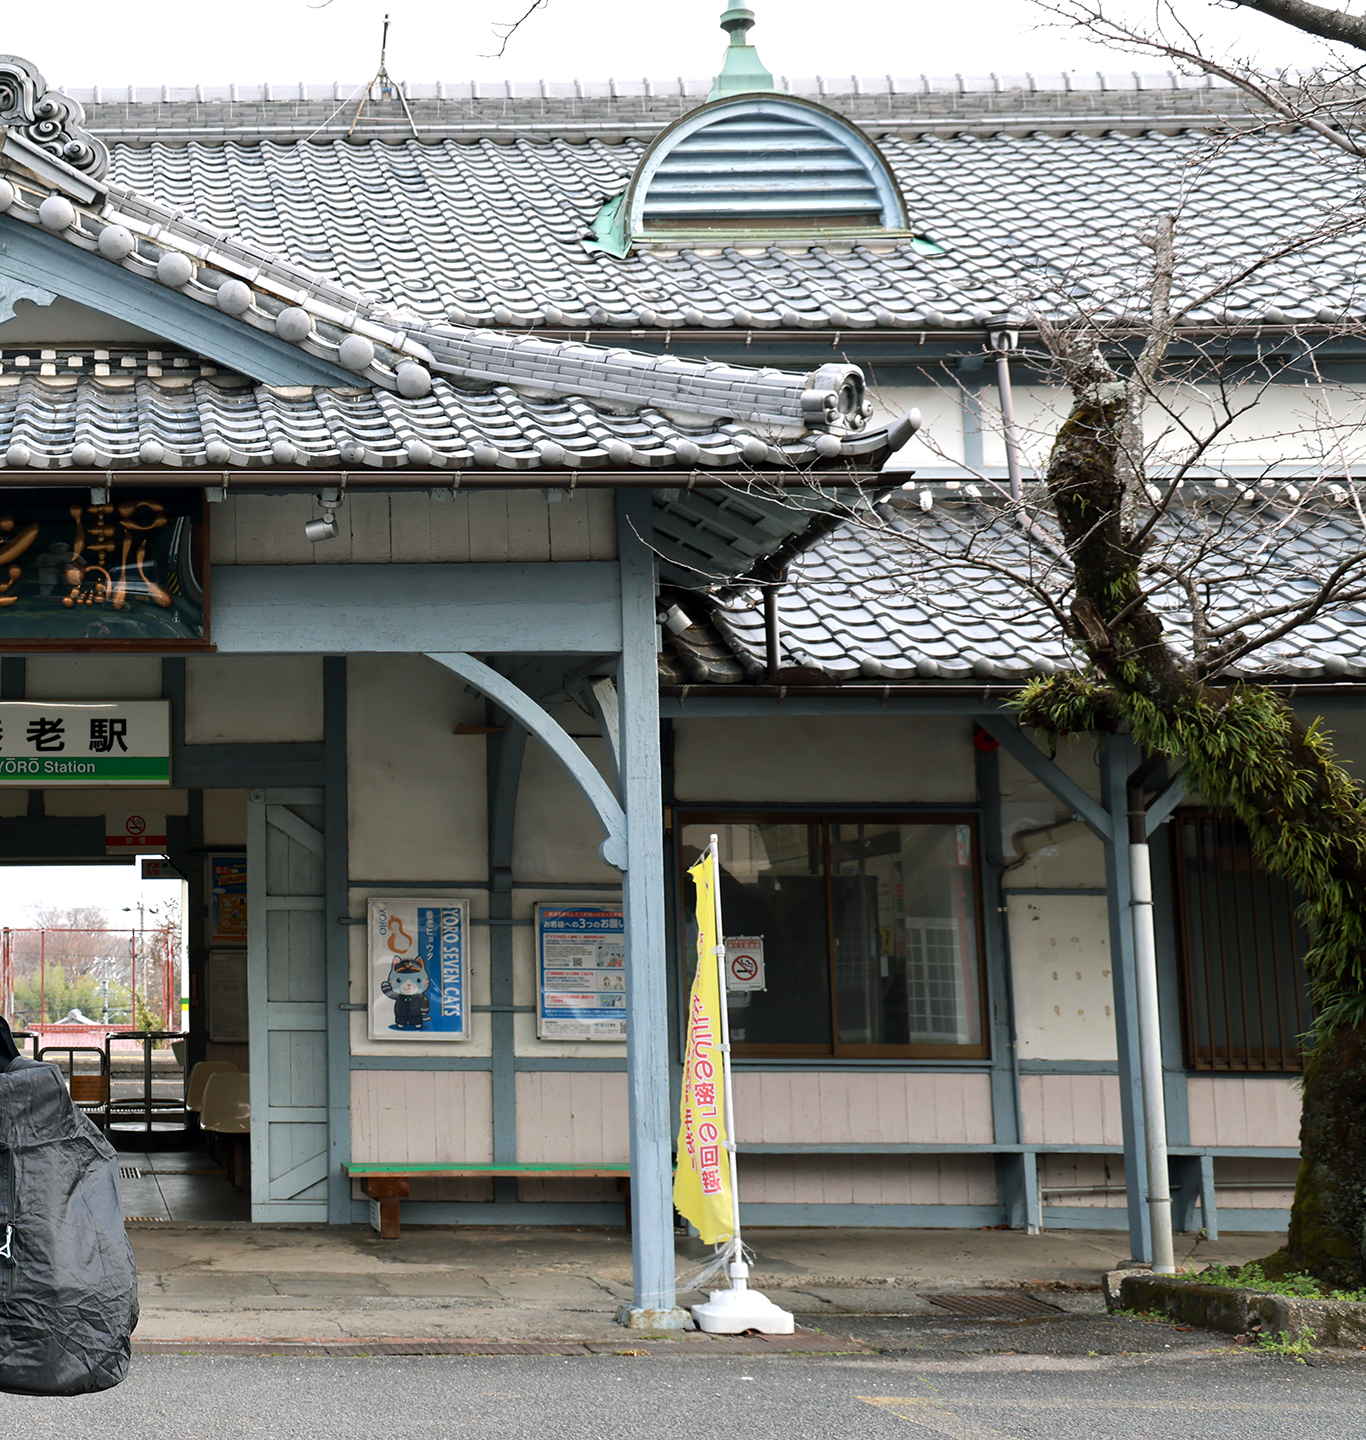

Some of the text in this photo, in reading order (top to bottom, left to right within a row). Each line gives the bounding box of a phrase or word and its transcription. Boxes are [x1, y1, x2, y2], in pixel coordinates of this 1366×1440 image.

[44, 761, 96, 774] Station
[125, 836, 146, 845] 禁煙
[379, 908, 387, 935] YORO
[443, 908, 461, 1017] YORO SEVEN CATS
